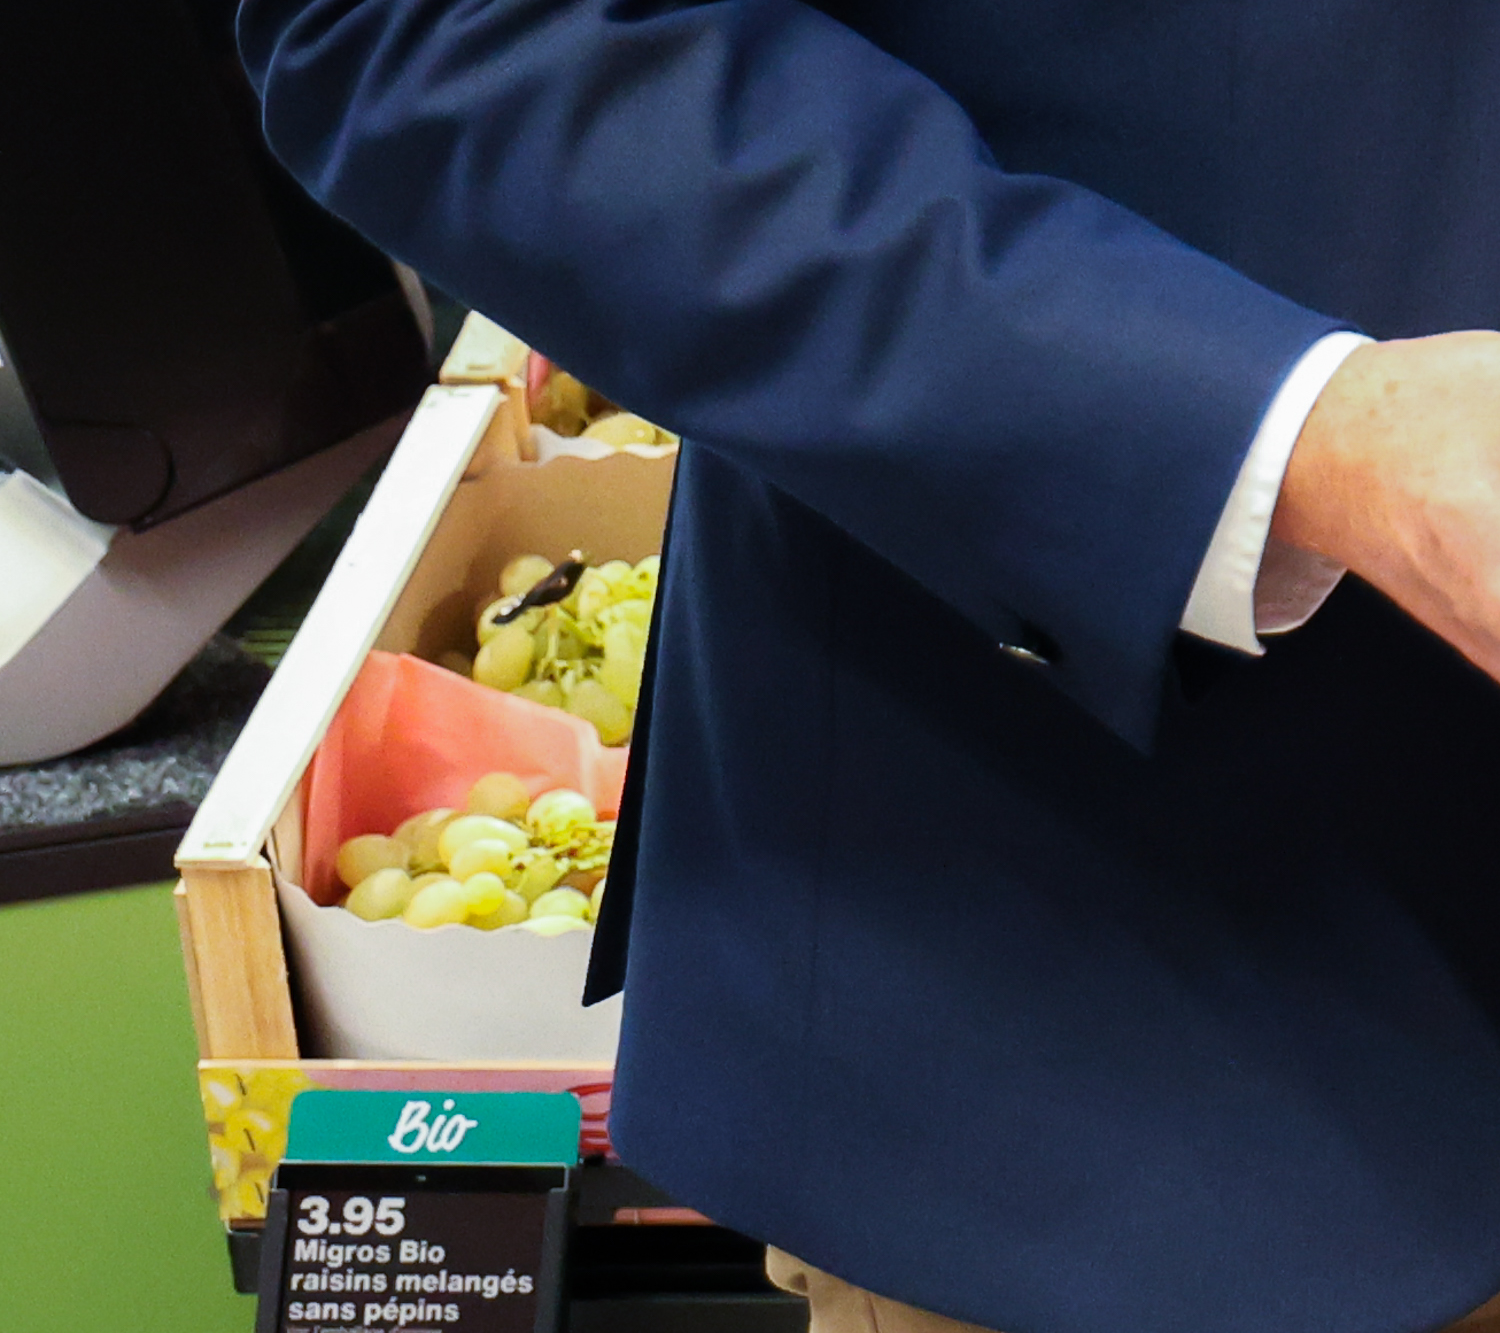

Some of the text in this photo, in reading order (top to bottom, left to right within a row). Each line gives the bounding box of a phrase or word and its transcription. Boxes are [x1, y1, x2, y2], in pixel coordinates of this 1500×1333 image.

[387, 1099, 479, 1153] Bio
[297, 1195, 406, 1235] 3.95
[293, 1239, 446, 1267] Migros Bio
[290, 1268, 534, 1298] raisins melangés
[288, 1296, 460, 1325] sans pépins
